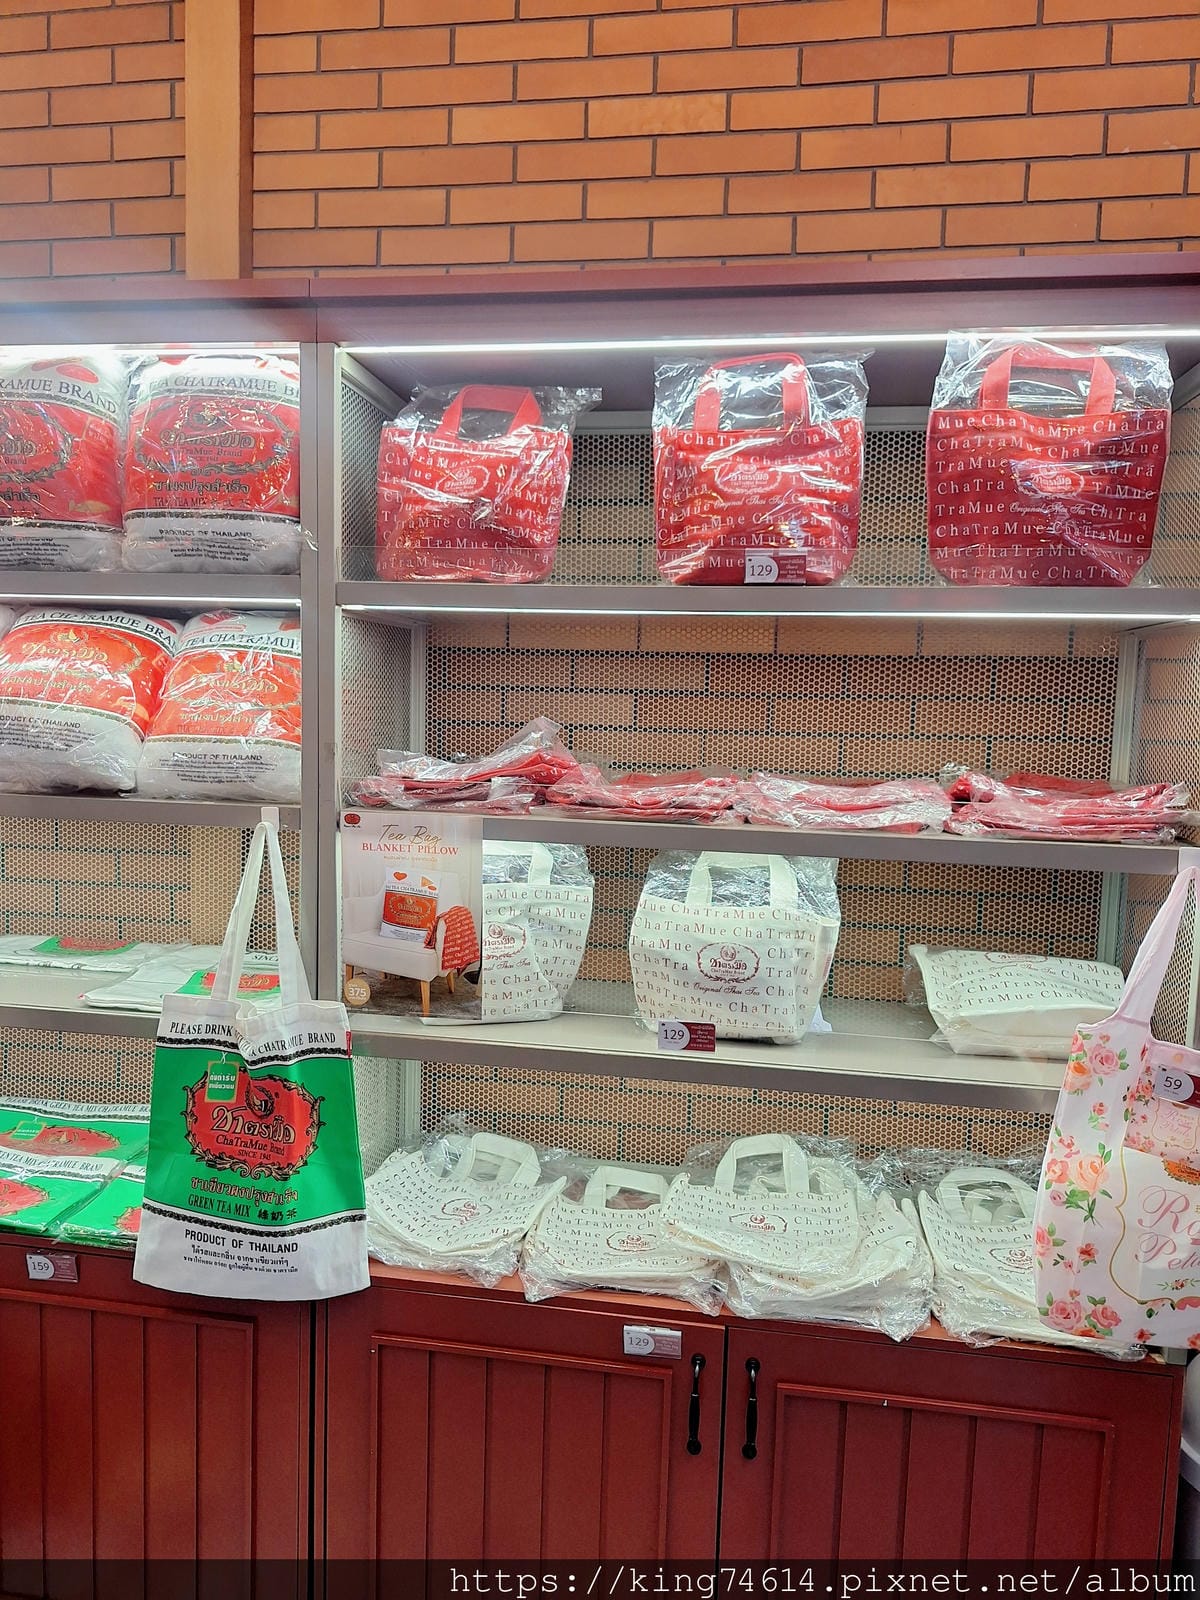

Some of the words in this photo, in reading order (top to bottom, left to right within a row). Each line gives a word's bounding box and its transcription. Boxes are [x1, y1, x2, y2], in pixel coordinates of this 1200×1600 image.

[174, 375, 278, 393] CHATRAMUE
[59, 381, 117, 415] BRAND
[938, 416, 975, 430] Mue
[1093, 418, 1164, 432] ChaTra
[937, 436, 1041, 455] ChaTraMue
[1048, 440, 1159, 459] ChaTraMue
[936, 456, 1009, 474] TraMue
[937, 478, 1005, 495] ChaTra
[935, 501, 1005, 517] TraMue
[937, 521, 1045, 538] ChaTraMue
[750, 564, 773, 577] 129
[379, 823, 407, 842] Tea
[409, 825, 442, 848] Bag
[362, 842, 412, 854] BLANKET
[417, 844, 459, 855] PILLOW
[534, 889, 590, 903] ChaTra
[671, 904, 766, 920] ChaTraMue
[634, 916, 727, 937] ChaTraMue
[631, 934, 692, 952] TraMue
[632, 953, 689, 971] ChaTra
[633, 966, 689, 988] TraMue
[1061, 969, 1122, 991] ChaTra
[348, 987, 367, 997] 375
[170, 1021, 203, 1035] PLEASE
[204, 1023, 234, 1037] DRINK
[258, 1033, 304, 1055] CHATRAMUE
[307, 1032, 337, 1044] BRAND
[663, 1029, 685, 1040] 129
[1163, 1076, 1182, 1090] 59
[211, 1105, 296, 1144] ชาตรามือ
[216, 1134, 268, 1151] ChaTraMue
[269, 1142, 285, 1156] Brand
[237, 1148, 257, 1159] SINCE
[259, 1152, 271, 1160] 1945
[188, 1194, 214, 1211] GREEN
[215, 1199, 232, 1214] TEA
[233, 1203, 252, 1218] MIX
[185, 1228, 227, 1247] PRODUCT
[231, 1238, 244, 1249] OF
[248, 1241, 299, 1254] THAILAND
[32, 1261, 50, 1271] 159
[628, 1336, 649, 1347] 129
